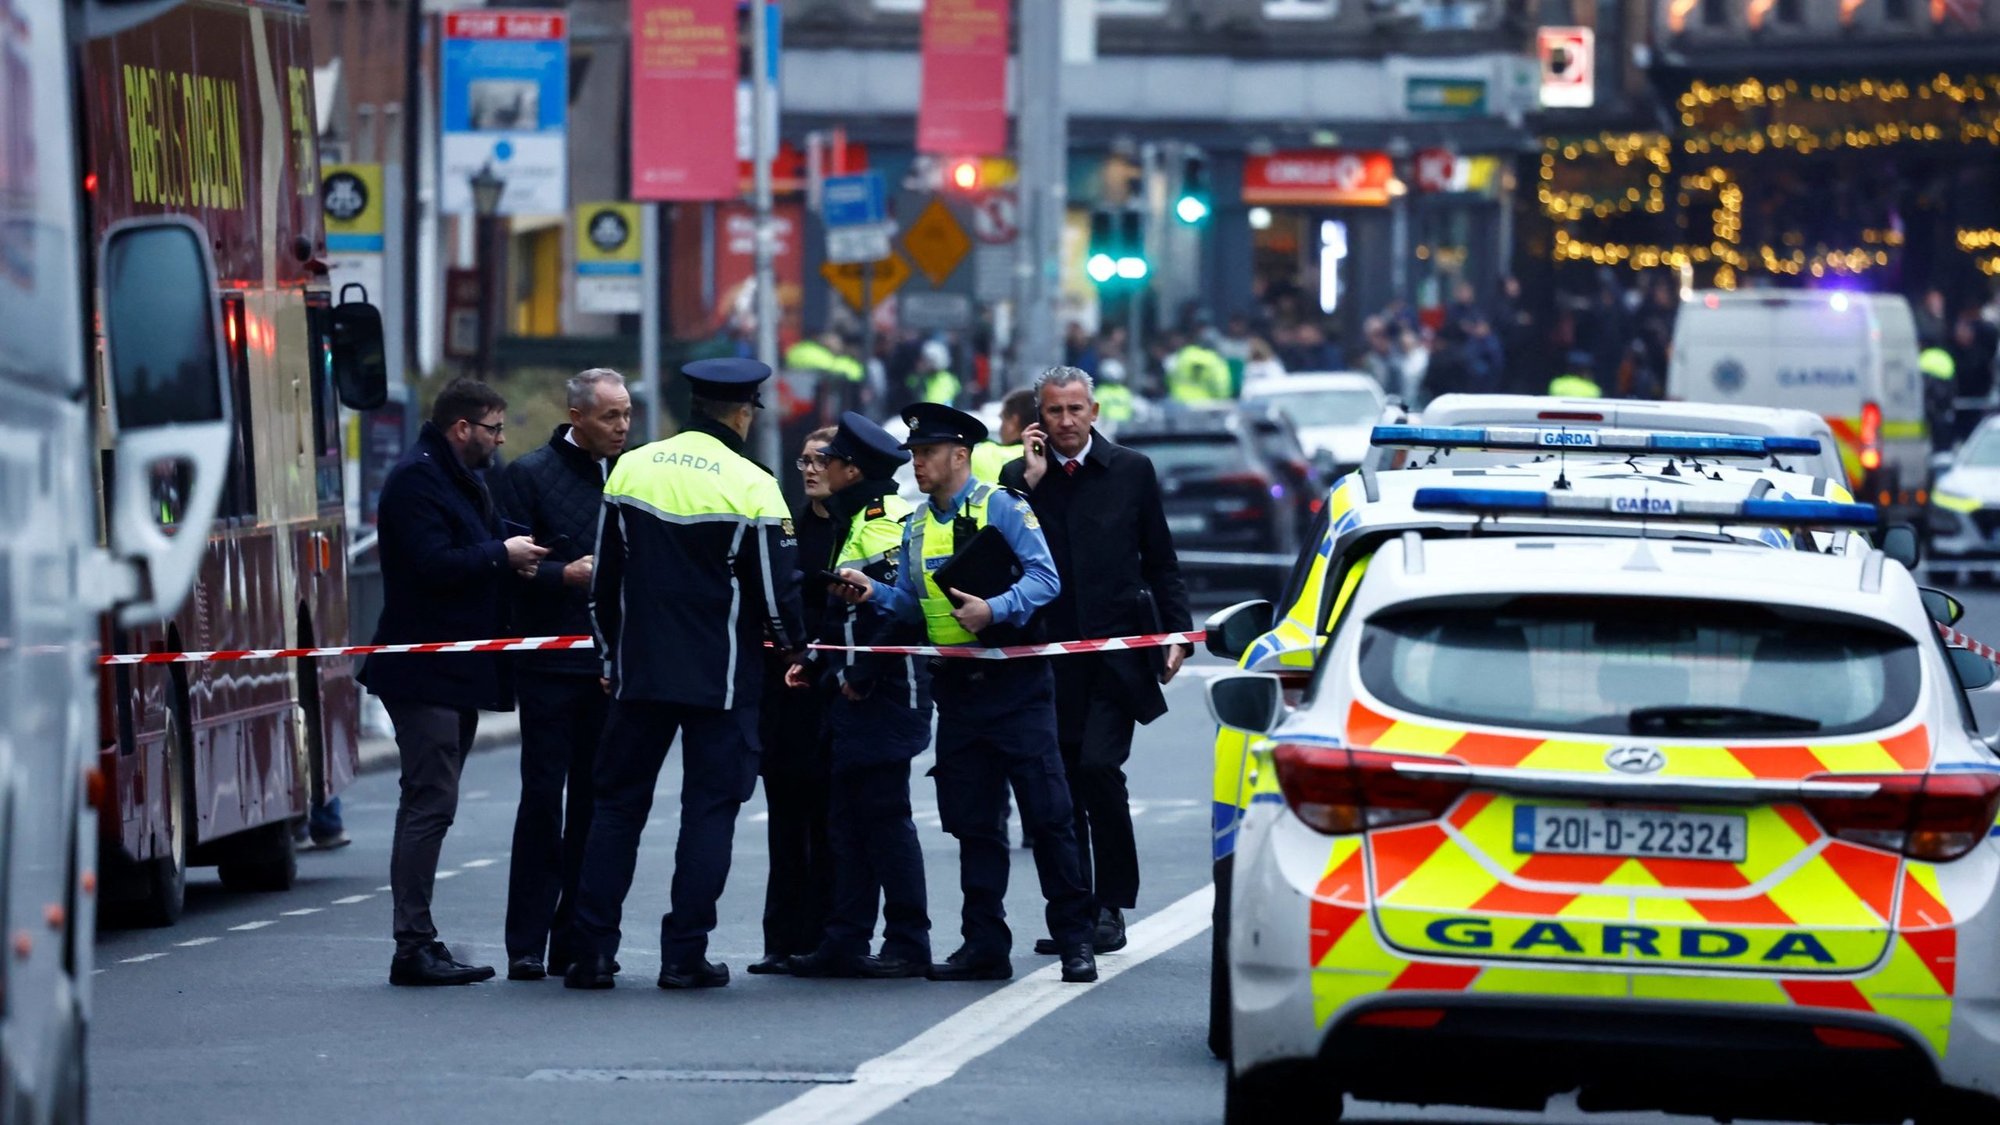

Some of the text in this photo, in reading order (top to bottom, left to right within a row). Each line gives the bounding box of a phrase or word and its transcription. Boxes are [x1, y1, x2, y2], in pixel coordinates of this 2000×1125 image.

[456, 18, 550, 36] FOR SALE
[182, 72, 243, 210] DUBLIN
[1545, 433, 1593, 445] GARDA
[652, 451, 721, 475] GARDA
[1616, 498, 1673, 512] GARDA
[1545, 816, 1733, 855] 201-D-22324
[1425, 917, 1837, 964] GARDA
